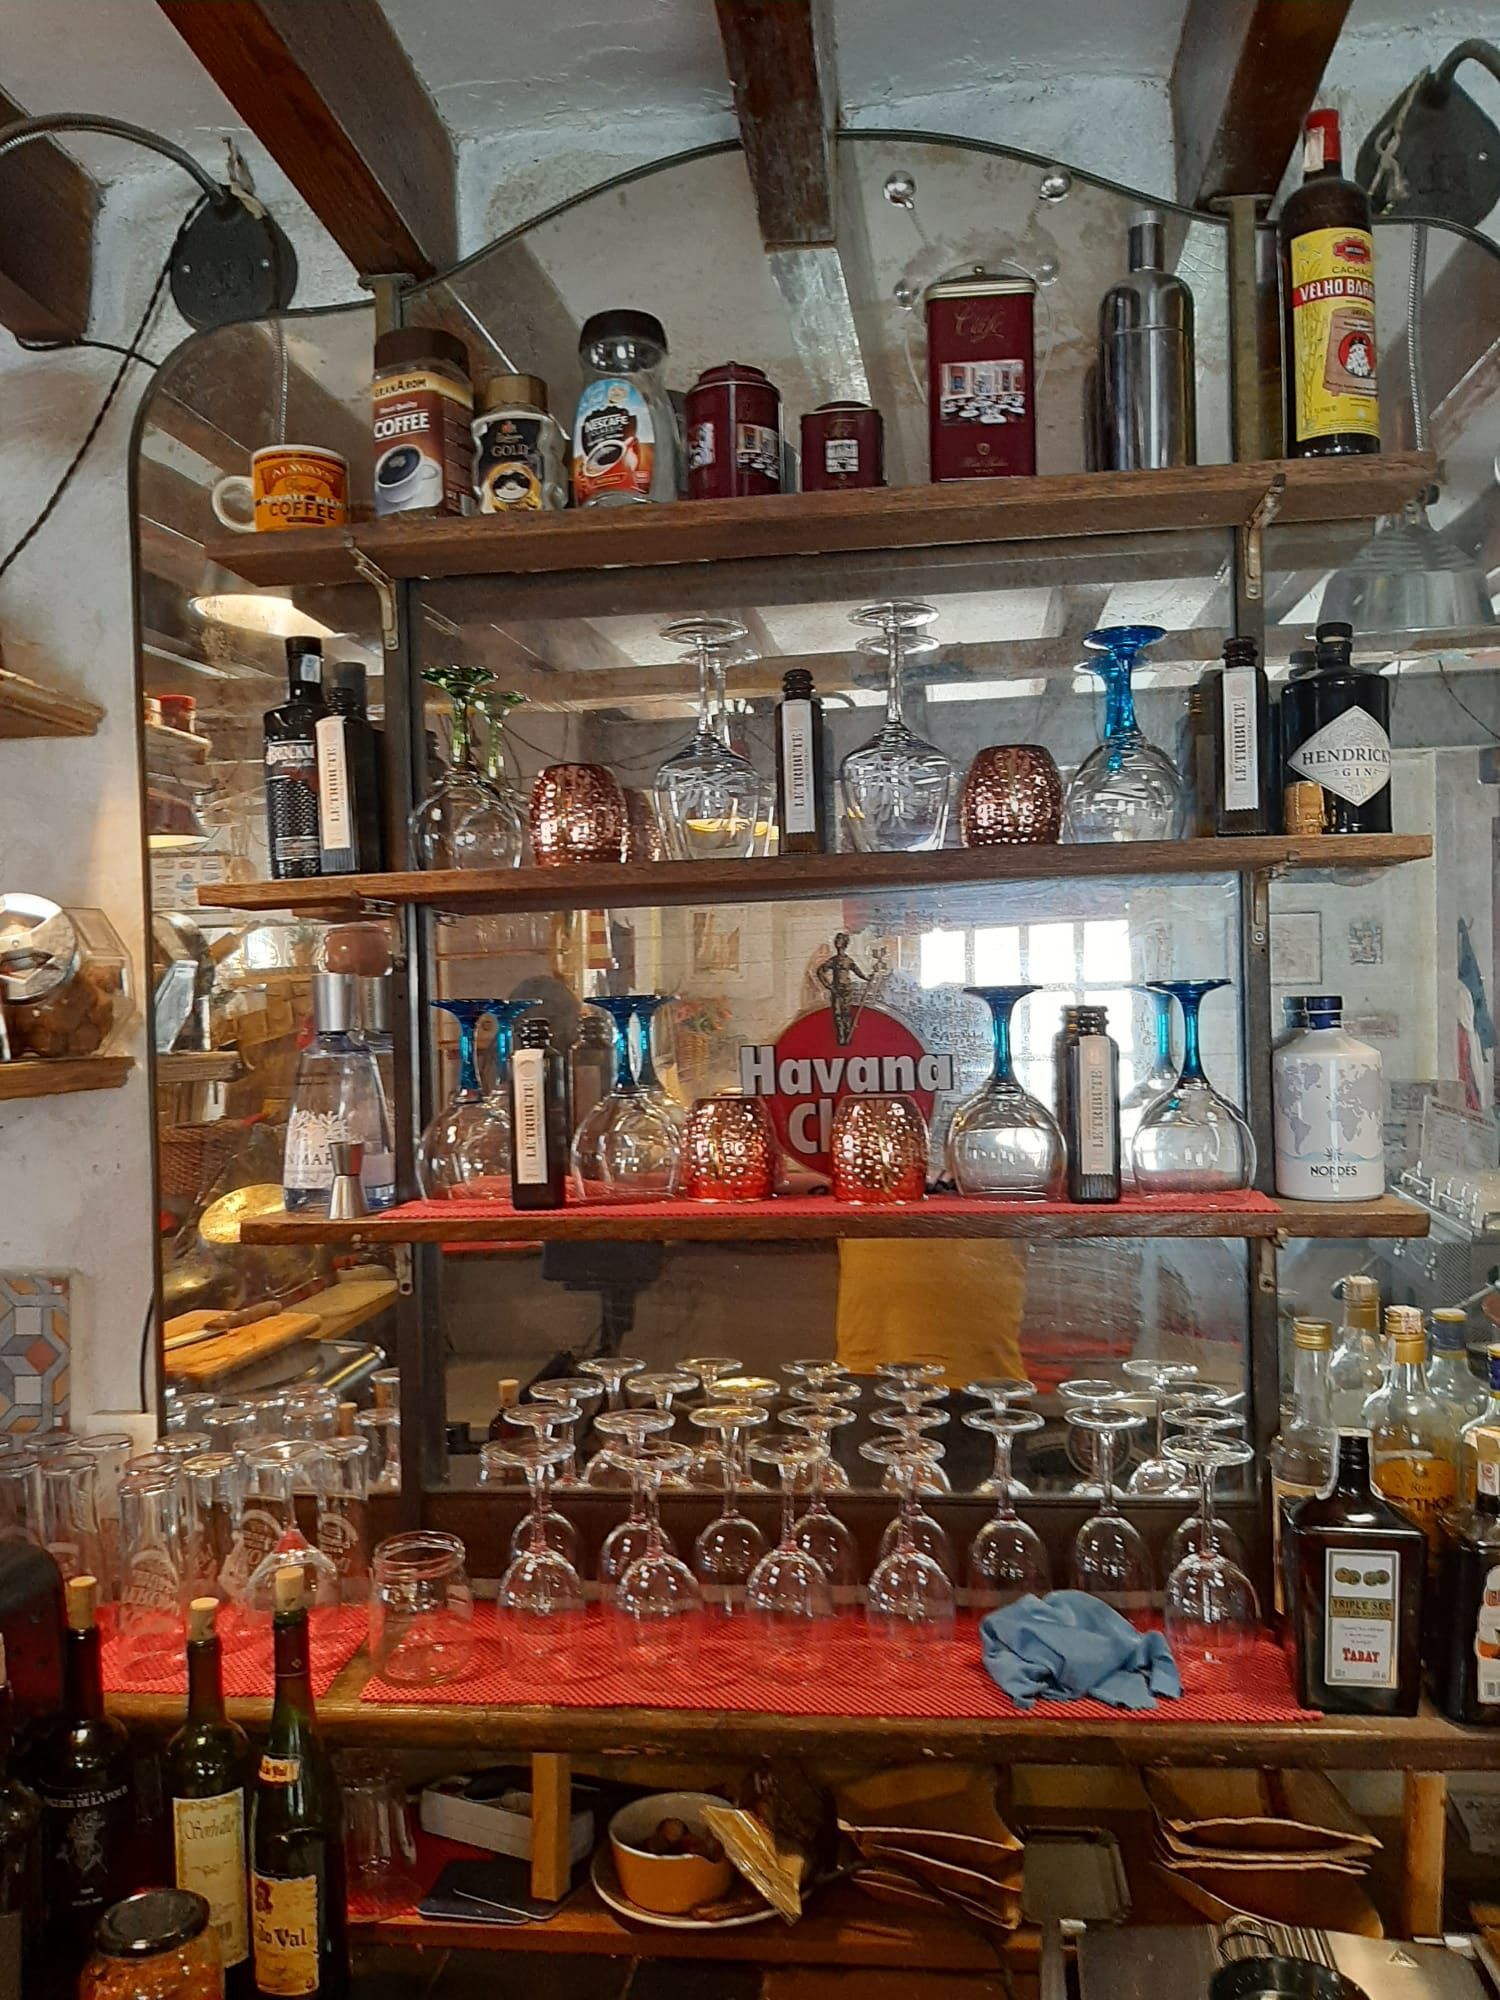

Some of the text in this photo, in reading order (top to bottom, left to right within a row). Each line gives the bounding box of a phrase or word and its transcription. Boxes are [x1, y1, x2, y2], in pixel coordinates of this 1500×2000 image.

[1300, 279, 1344, 301] VELHO
[374, 411, 430, 438] COFFEE
[492, 444, 530, 457] GOLD
[270, 501, 337, 521] COFFEE
[1342, 767, 1373, 778] GIN
[741, 1044, 955, 1097] Havana
[788, 1098, 833, 1155] Cl
[1333, 1599, 1392, 1611] TRIPLE SEC
[1342, 1647, 1380, 1663] TABAY
[274, 1928, 307, 1949] Val
